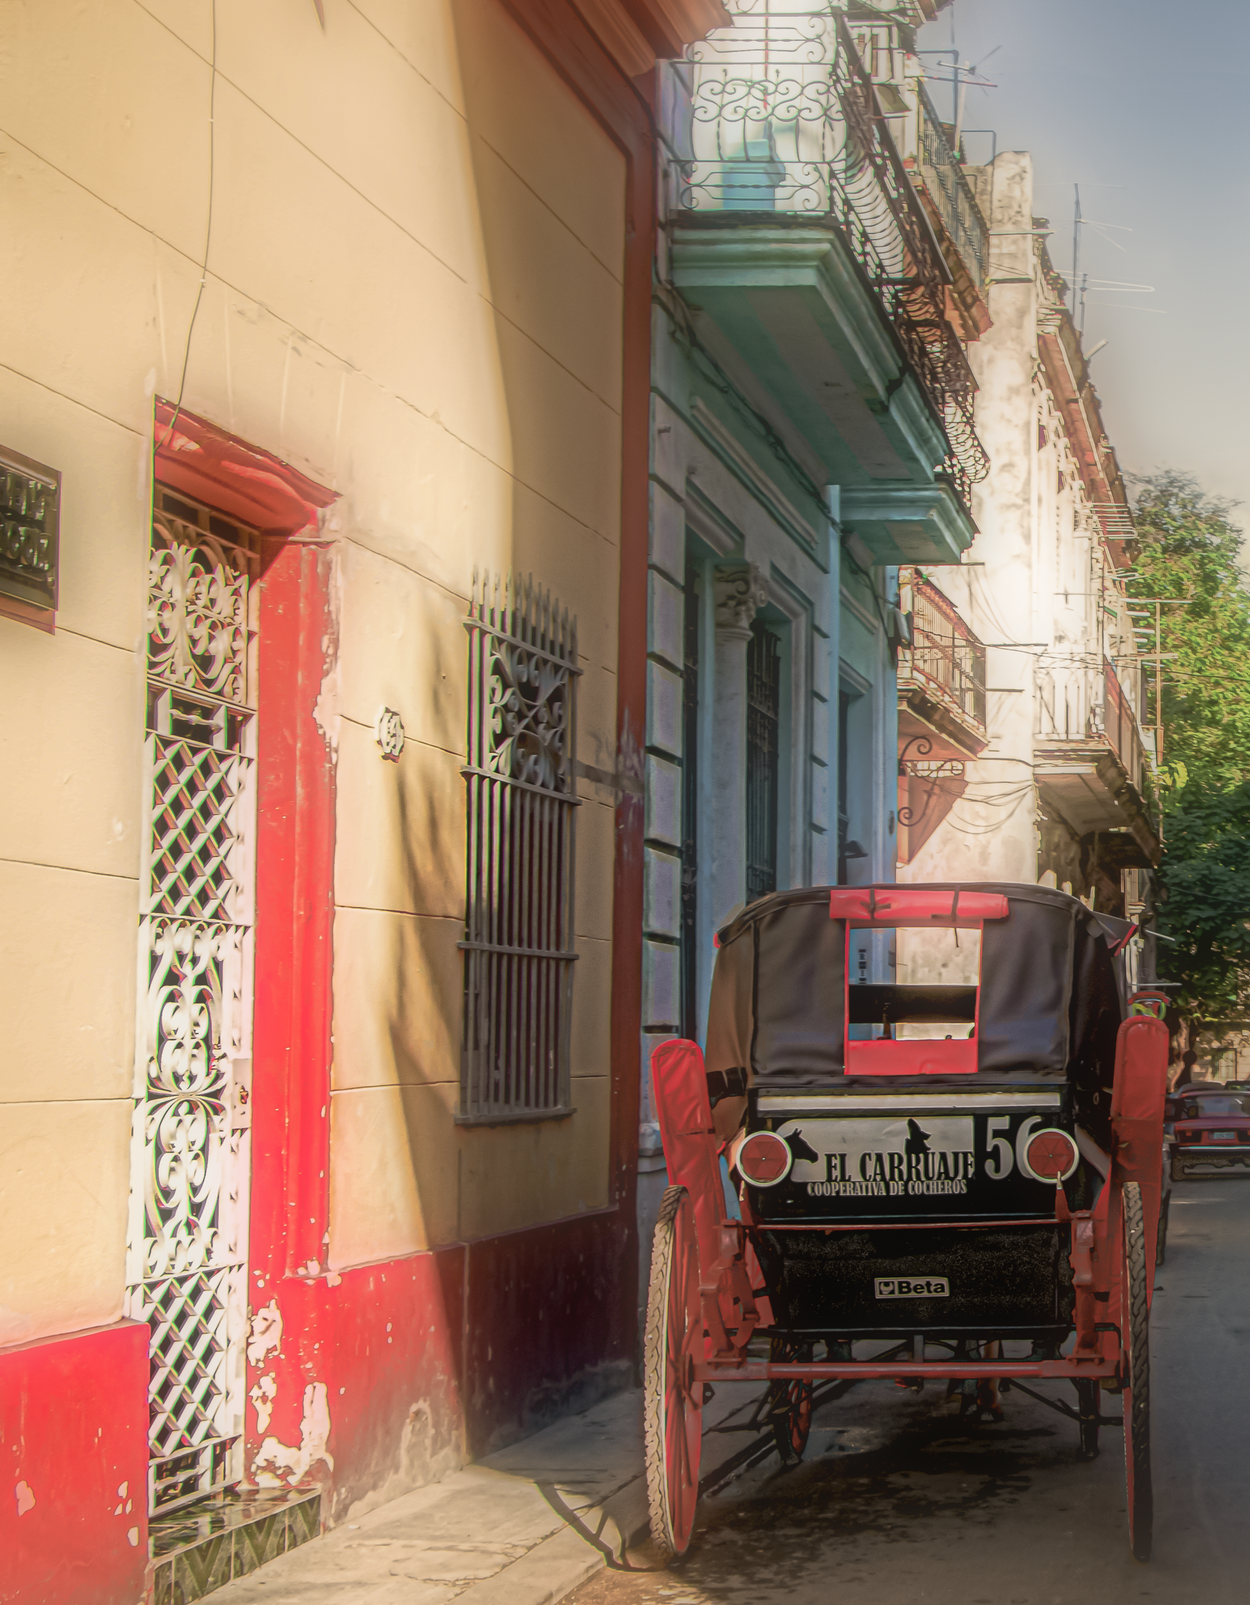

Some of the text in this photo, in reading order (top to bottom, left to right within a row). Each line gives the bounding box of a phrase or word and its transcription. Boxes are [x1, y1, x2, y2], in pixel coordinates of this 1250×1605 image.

[824, 1151, 975, 1182] EL CARRUAJE
[807, 1179, 968, 1196] COOPERATIVA DE COCHEROS
[897, 1280, 946, 1295] Beta
